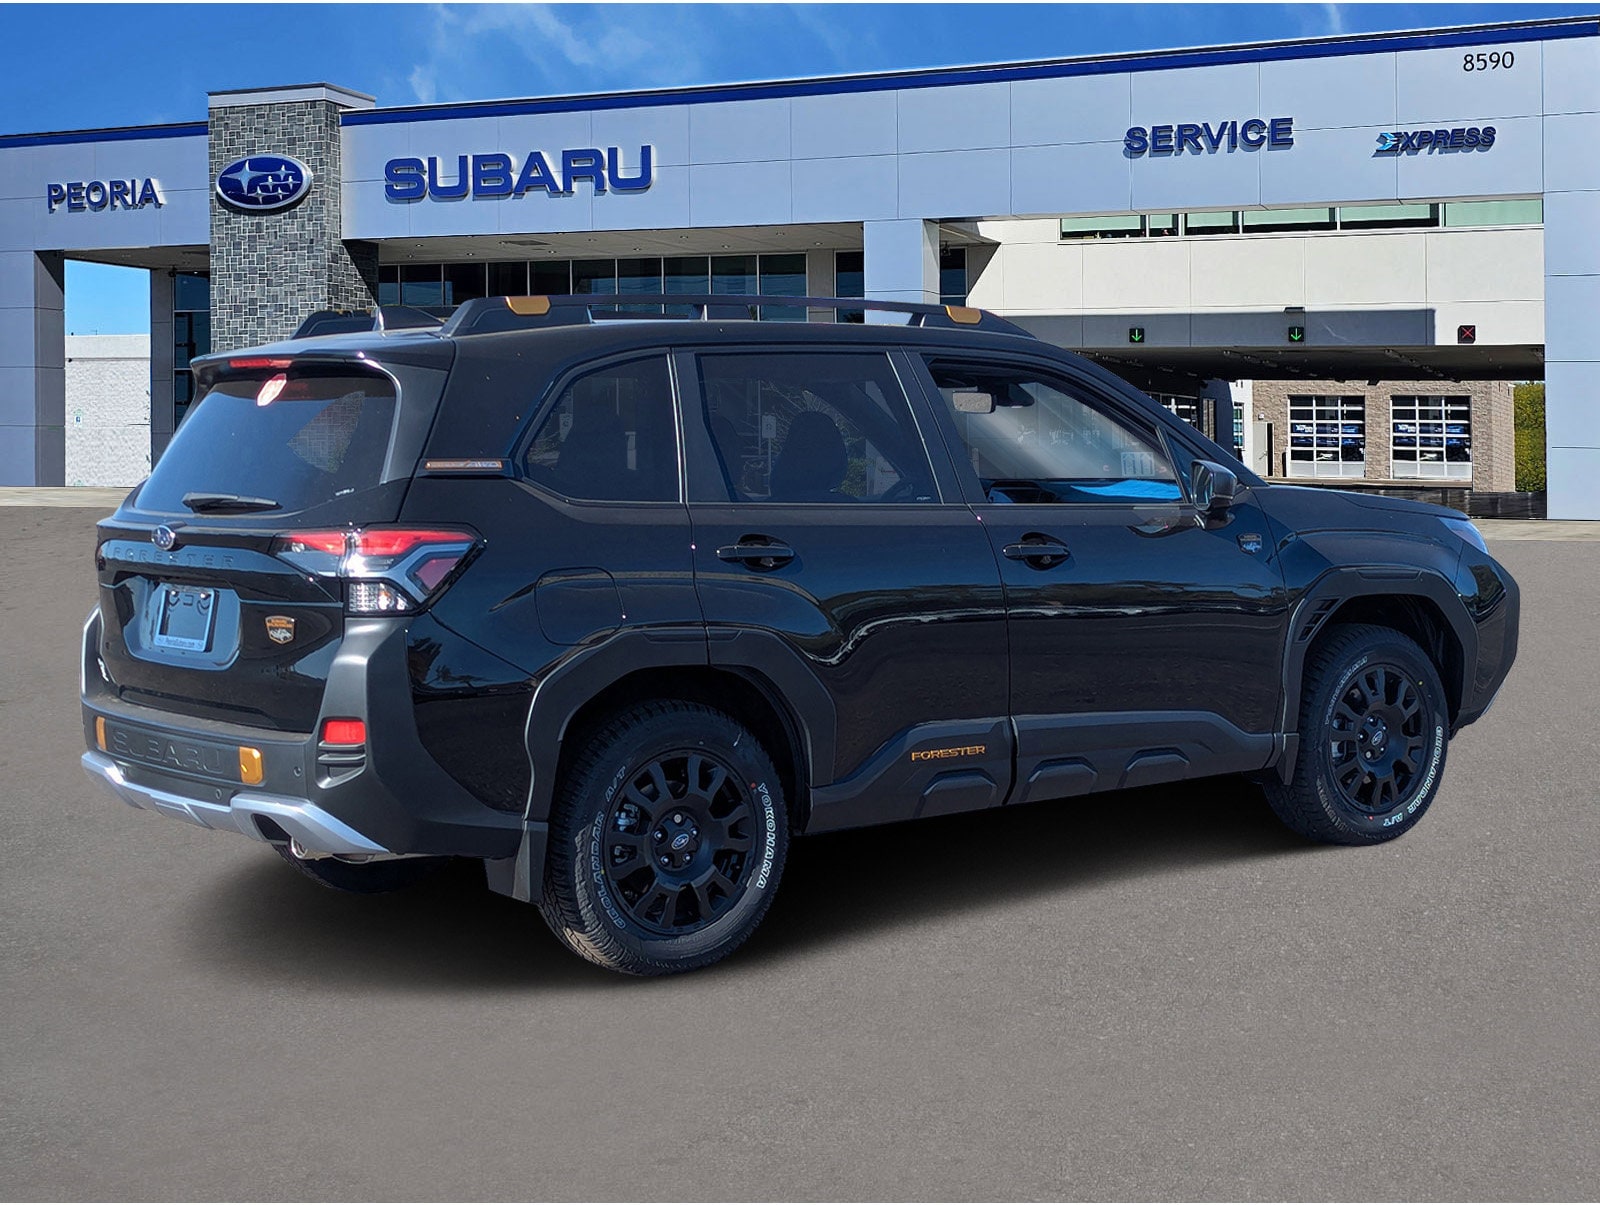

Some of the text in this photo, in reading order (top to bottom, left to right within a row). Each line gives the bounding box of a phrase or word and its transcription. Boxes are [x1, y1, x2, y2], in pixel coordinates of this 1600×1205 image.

[1462, 51, 1515, 72] 8590
[1125, 117, 1294, 154] SERVICE
[1376, 126, 1497, 152] EXPRESS
[384, 144, 652, 200] SUBARU
[47, 178, 161, 211] PEORIA
[112, 730, 224, 774] SUBARU
[911, 745, 987, 762] FORESTER
[756, 782, 777, 889] YOKOHAMA
